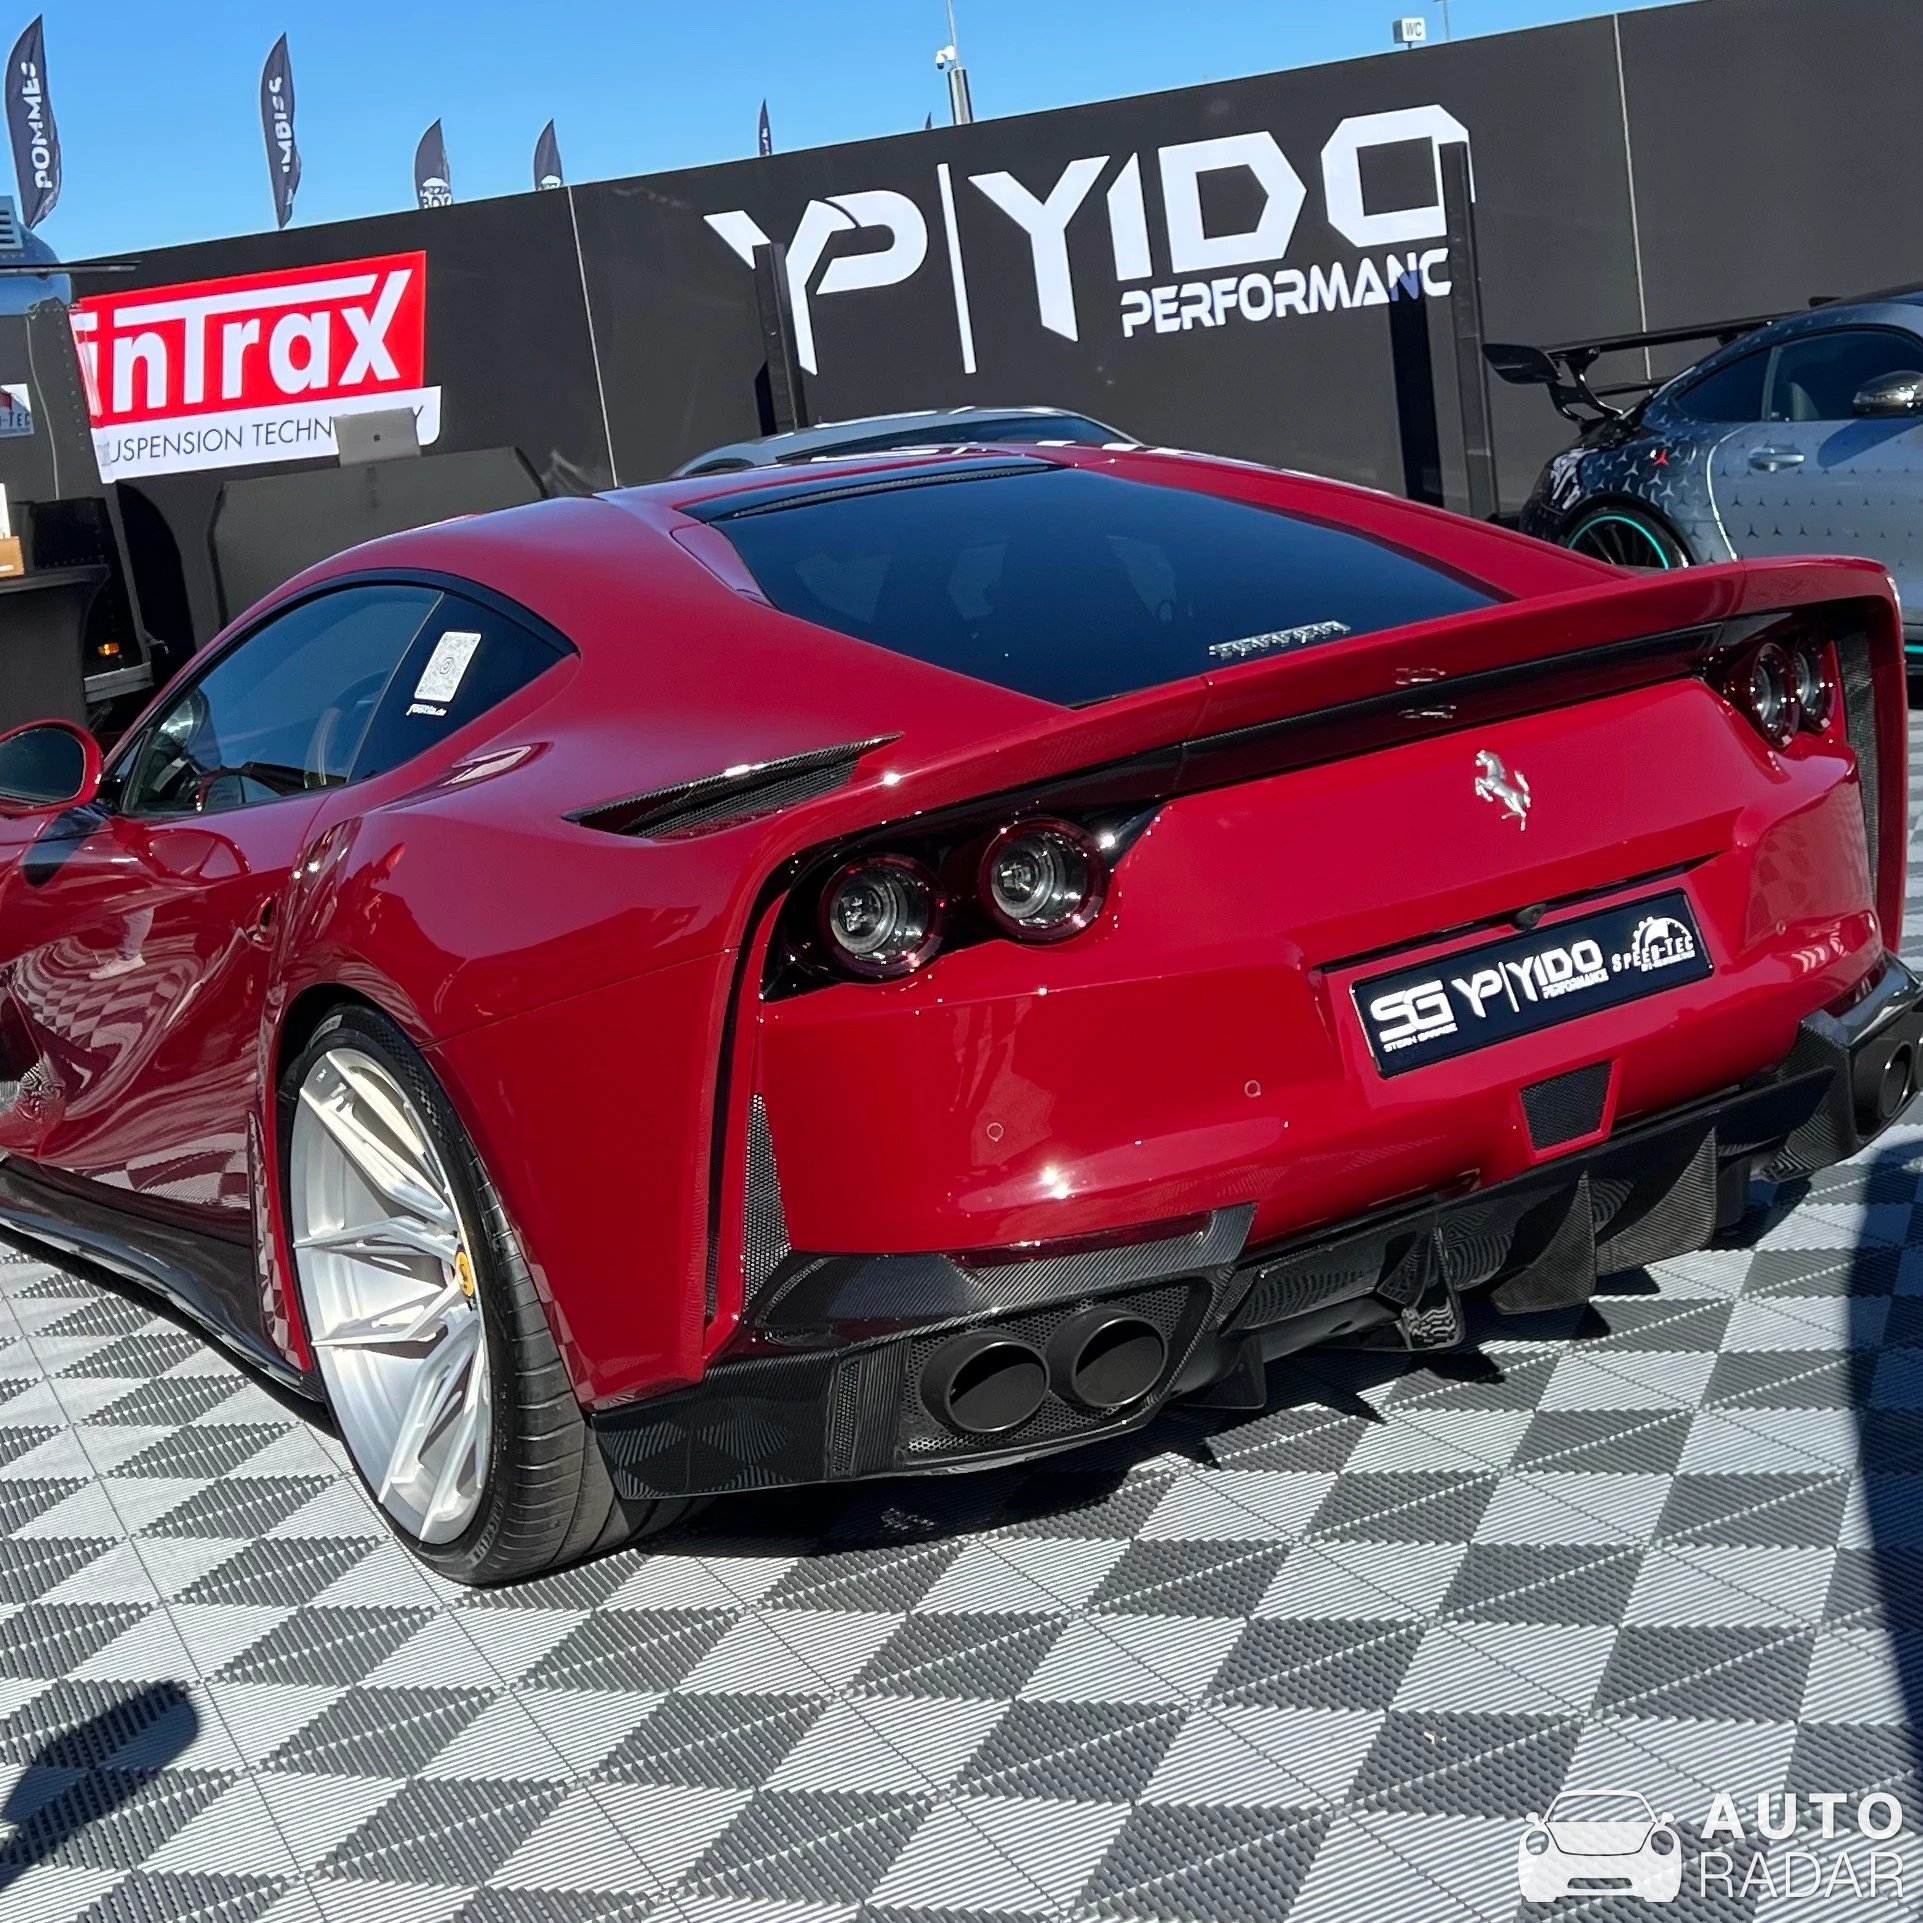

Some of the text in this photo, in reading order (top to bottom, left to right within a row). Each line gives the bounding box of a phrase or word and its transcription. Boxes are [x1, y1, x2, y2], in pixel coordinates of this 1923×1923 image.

[1405, 21, 1422, 37] WC
[21, 62, 53, 189] POMMES
[1120, 248, 1452, 338] PERFORMANC
[110, 424, 243, 463] USPENSION
[1370, 979, 1455, 1043] SG
